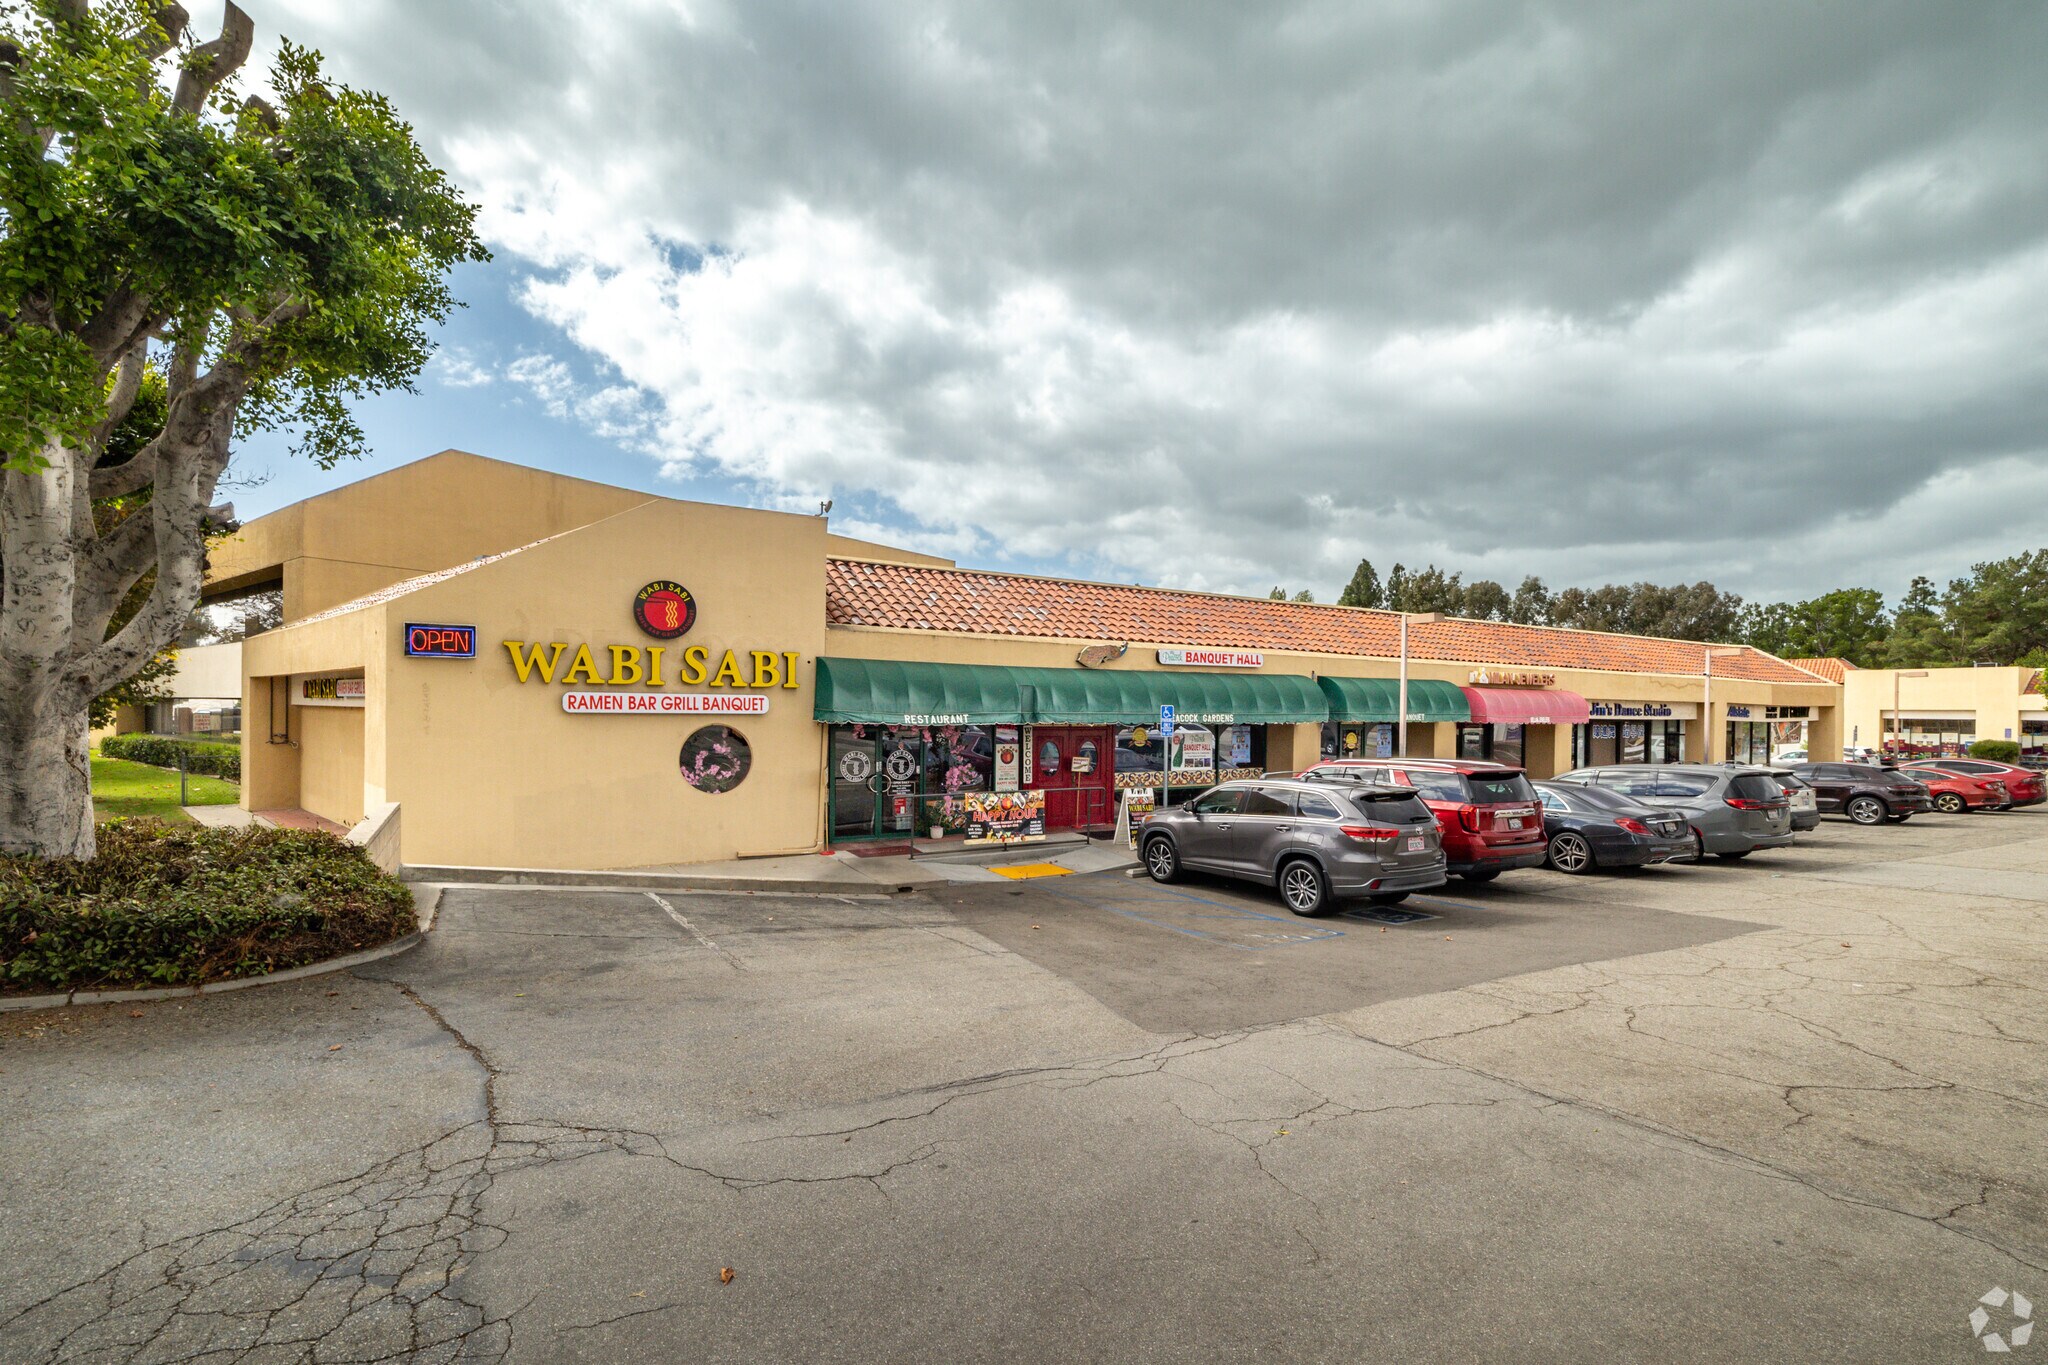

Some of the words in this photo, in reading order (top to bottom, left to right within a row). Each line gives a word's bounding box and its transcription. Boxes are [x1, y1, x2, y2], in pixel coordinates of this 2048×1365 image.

[638, 582, 664, 600] WABI
[668, 583, 691, 602] SABI
[411, 629, 469, 652] OPEN
[503, 640, 666, 686] WABI
[681, 645, 801, 689] SABI
[1185, 651, 1234, 665] BANQUET
[1236, 654, 1262, 666] HALL
[1488, 671, 1514, 685] MILAN
[1516, 673, 1556, 687] JEWELERS
[568, 694, 623, 711] RAMEN
[628, 695, 657, 712] BAR
[661, 696, 699, 712] GRILL
[702, 697, 766, 713] BANQUET
[1614, 702, 1643, 717] Dance
[1643, 703, 1672, 717] Studio
[903, 714, 969, 724] RESTAURANT
[1172, 713, 1199, 723] EACOCK
[1202, 713, 1234, 723] GARDENS
[1405, 713, 1425, 721] ANQUET
[1727, 705, 1751, 719] Allstate
[1024, 727, 1032, 782] WELCOME
[1183, 743, 1201, 752] BANQUET
[1202, 743, 1212, 751] HALL
[890, 751, 902, 761] WABI
[902, 751, 913, 761] SABI
[973, 810, 1008, 822] HAPPY
[1009, 808, 1038, 820] HOUR
